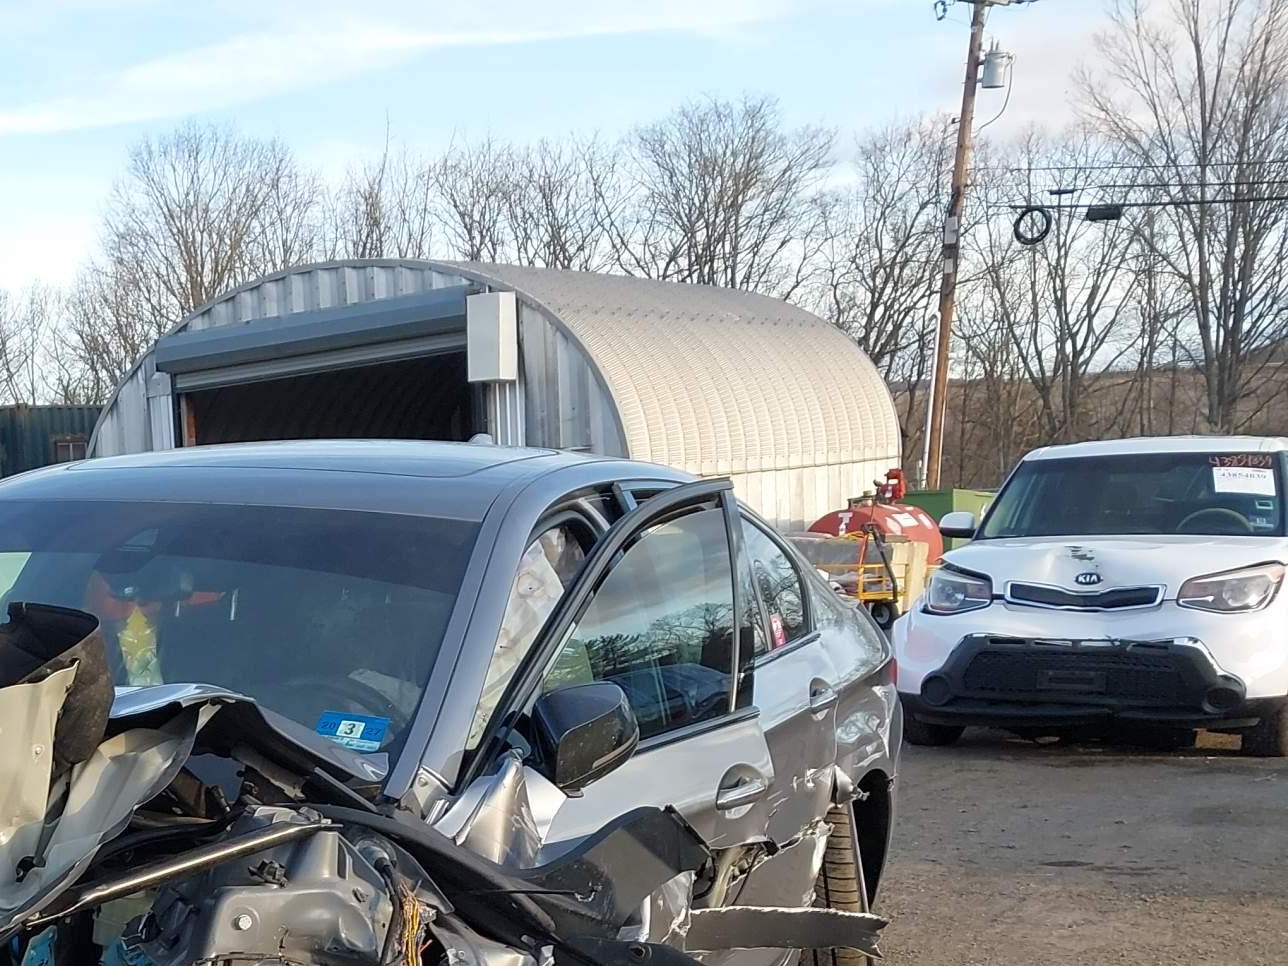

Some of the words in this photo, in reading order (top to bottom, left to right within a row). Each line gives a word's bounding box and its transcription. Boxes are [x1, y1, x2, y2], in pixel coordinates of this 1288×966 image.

[1078, 574, 1098, 583] KIA
[321, 721, 337, 730] 20
[343, 722, 356, 735] 3
